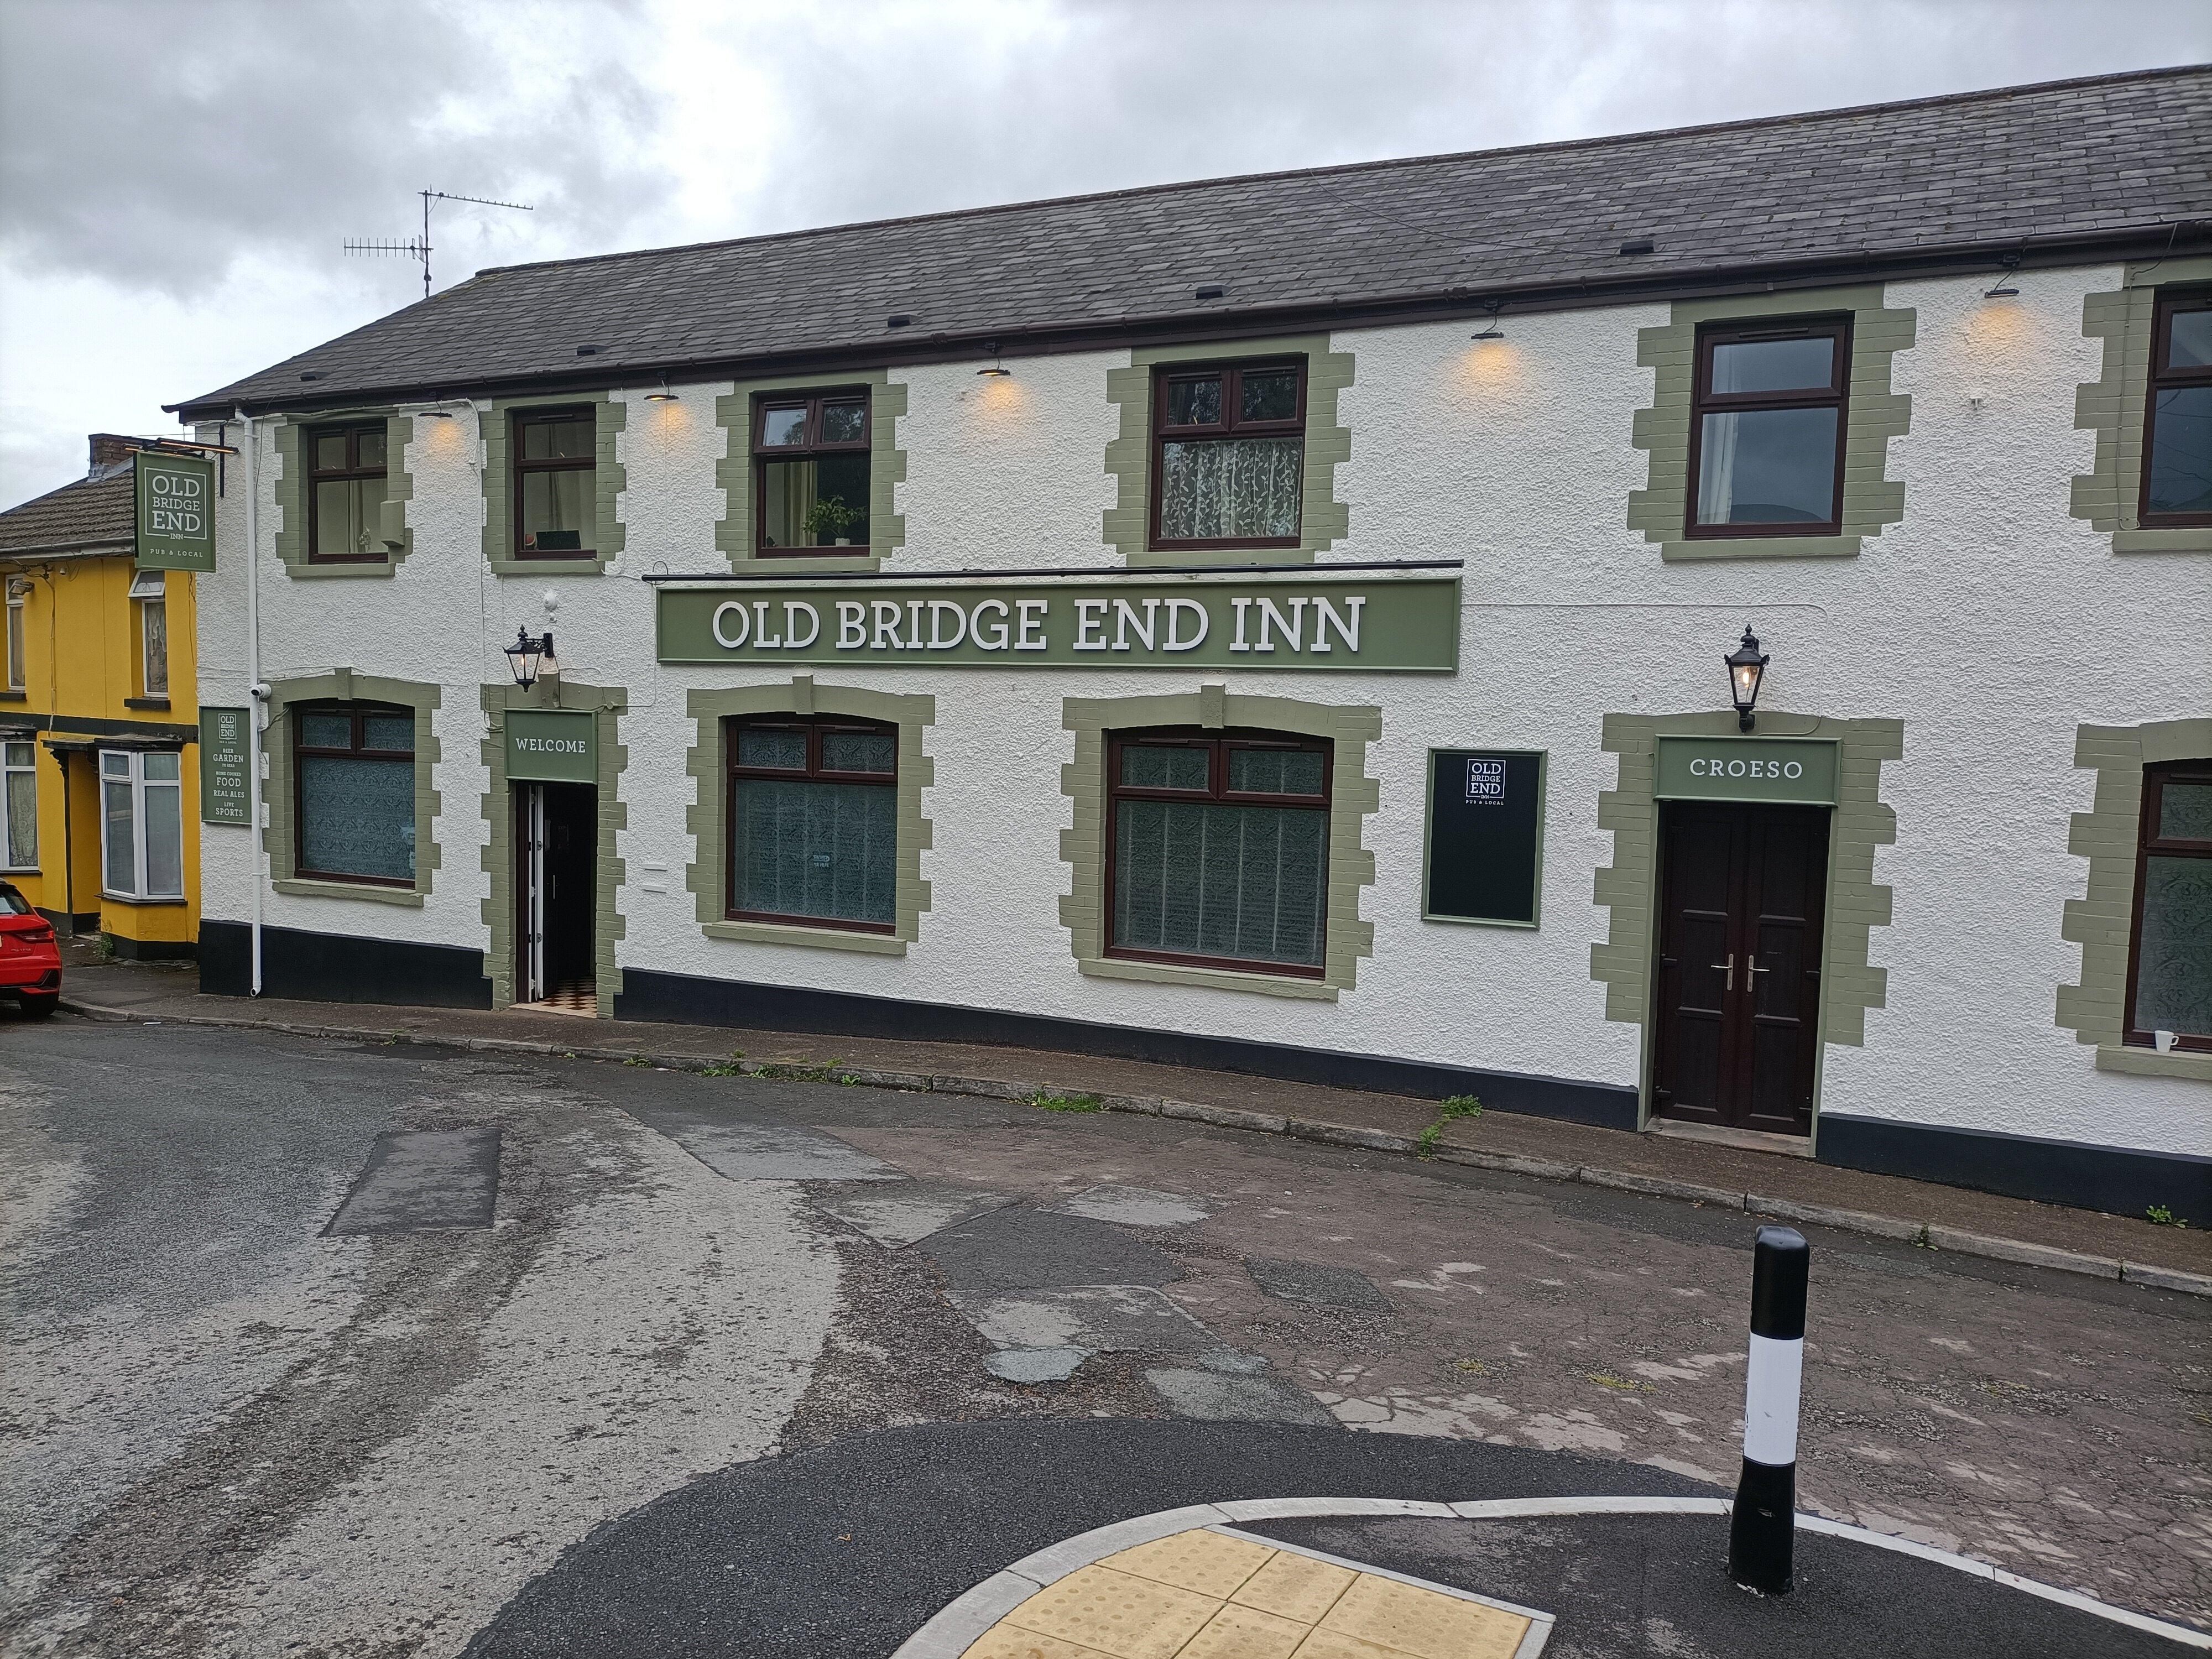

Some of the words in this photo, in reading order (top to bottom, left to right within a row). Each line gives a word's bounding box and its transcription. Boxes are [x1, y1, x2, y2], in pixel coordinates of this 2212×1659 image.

[152, 475, 200, 497] OLD
[152, 497, 200, 512] BRIDGE
[152, 510, 201, 532] END
[712, 601, 820, 648] OLD
[835, 599, 1048, 650] BRIDGE
[1073, 598, 1209, 651] END
[1229, 596, 1366, 651] INN
[515, 738, 586, 753] WELCOME
[213, 754, 244, 763] GARDEN
[1472, 763, 1501, 775] OLD
[1689, 758, 1803, 779] CROESO
[216, 777, 242, 787] FOOD
[1470, 782, 1501, 794] END
[215, 808, 243, 817] SPORTS
